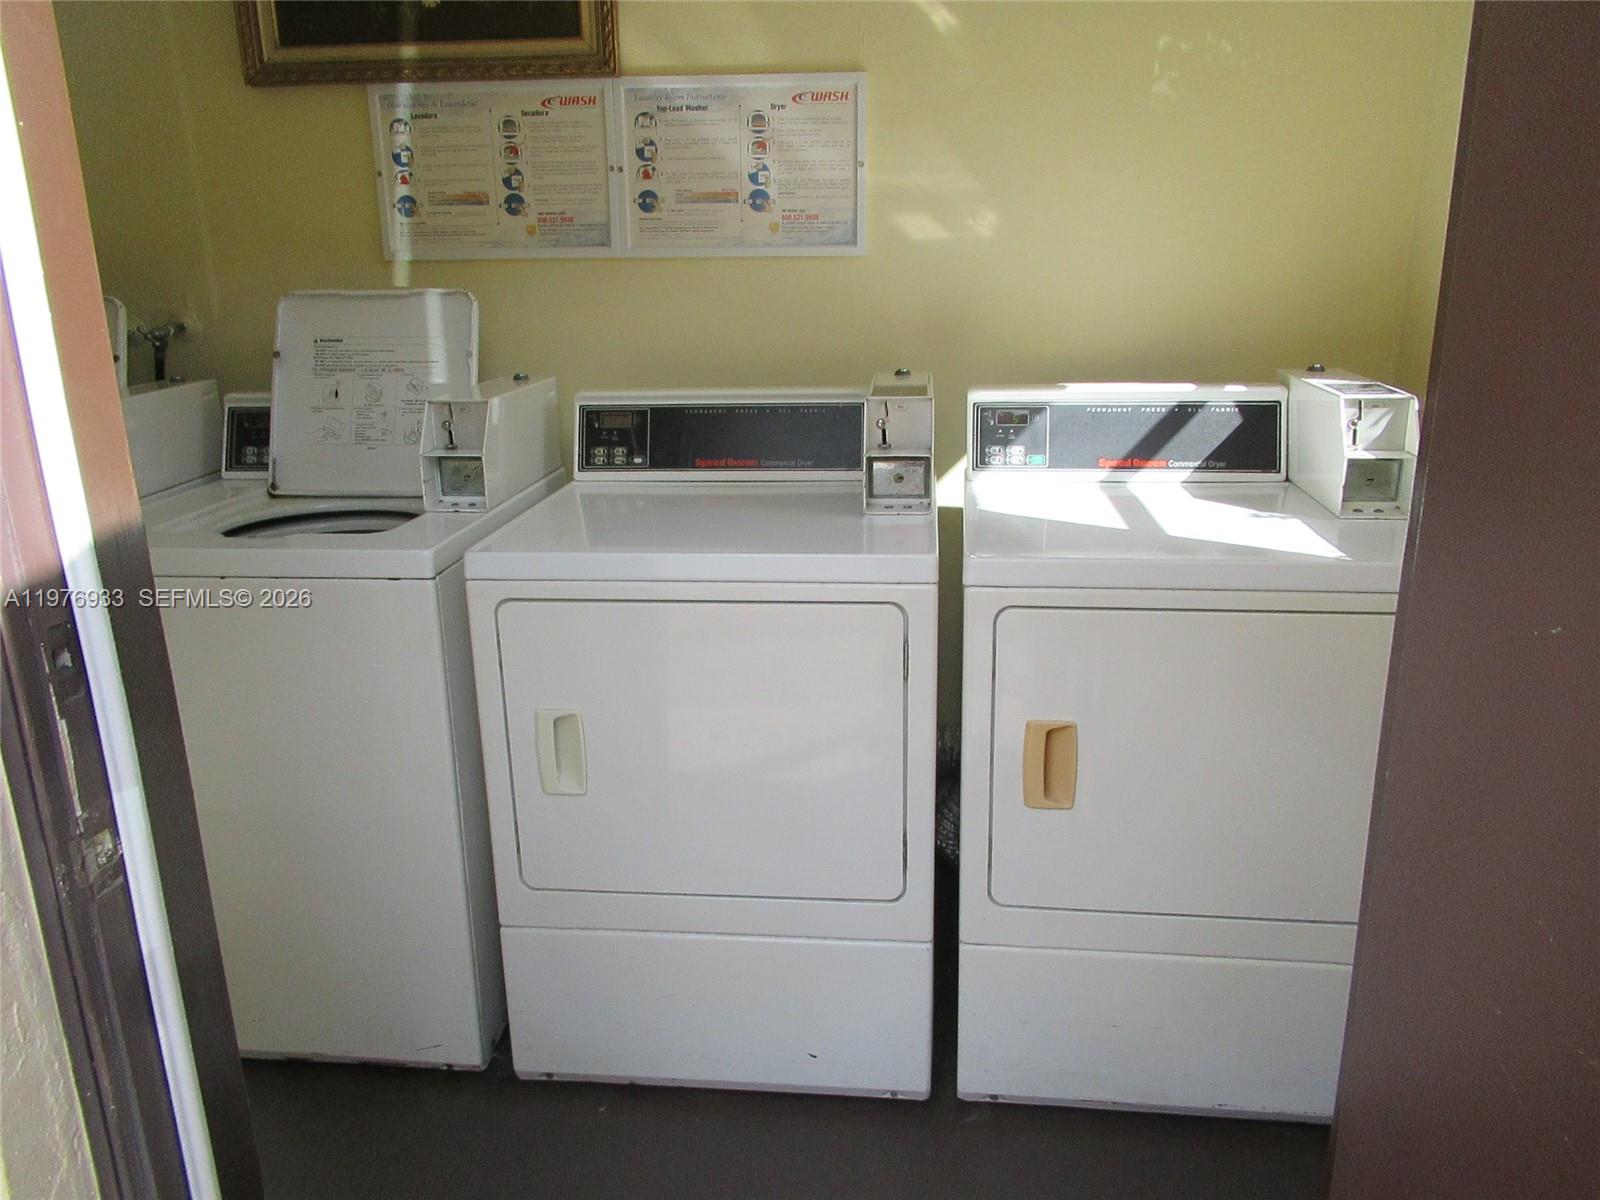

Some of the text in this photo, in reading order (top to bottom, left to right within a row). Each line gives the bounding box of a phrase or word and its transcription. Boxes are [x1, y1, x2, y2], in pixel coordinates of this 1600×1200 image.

[560, 96, 597, 106] WASH
[811, 91, 849, 102] WASH
[656, 103, 709, 113] Top-Load Washer
[770, 103, 787, 112] Dryer
[695, 458, 815, 468] Speed Queen Commercial Dryer
[1098, 459, 1227, 469] Speed Queen Commercial Dryer
